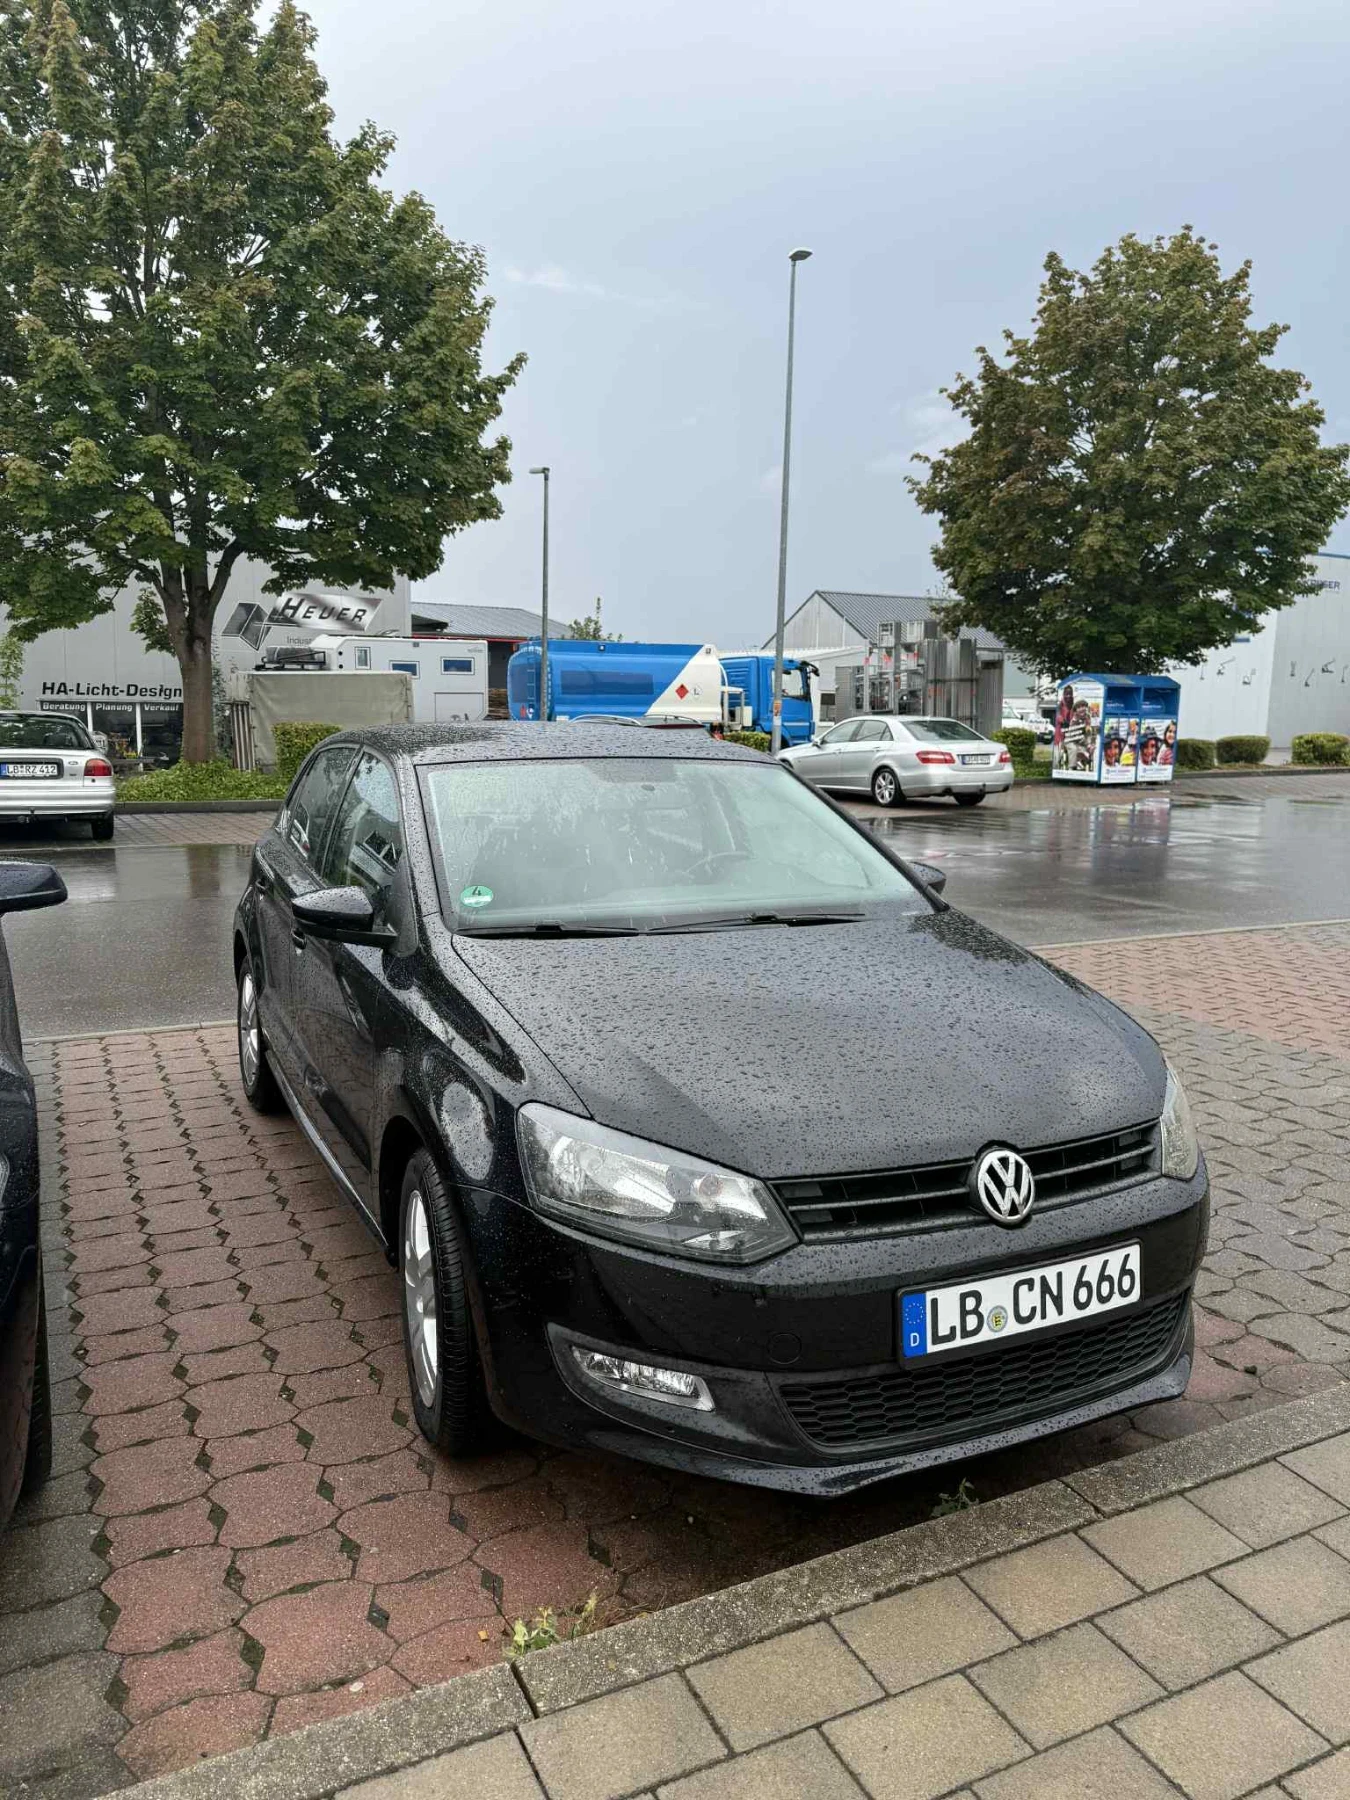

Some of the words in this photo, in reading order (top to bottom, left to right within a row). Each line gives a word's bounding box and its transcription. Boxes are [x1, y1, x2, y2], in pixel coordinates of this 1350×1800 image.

[281, 598, 367, 622] HEUER
[42, 682, 182, 699] HA-Licht-Design
[43, 703, 85, 711] Beratung
[7, 765, 21, 774] LB
[472, 886, 482, 896] 4
[979, 1150, 1035, 1221] VW
[930, 1289, 984, 1345] LB
[1013, 1271, 1063, 1324] CN
[1073, 1253, 1136, 1311] 666
[910, 1332, 920, 1347] D
